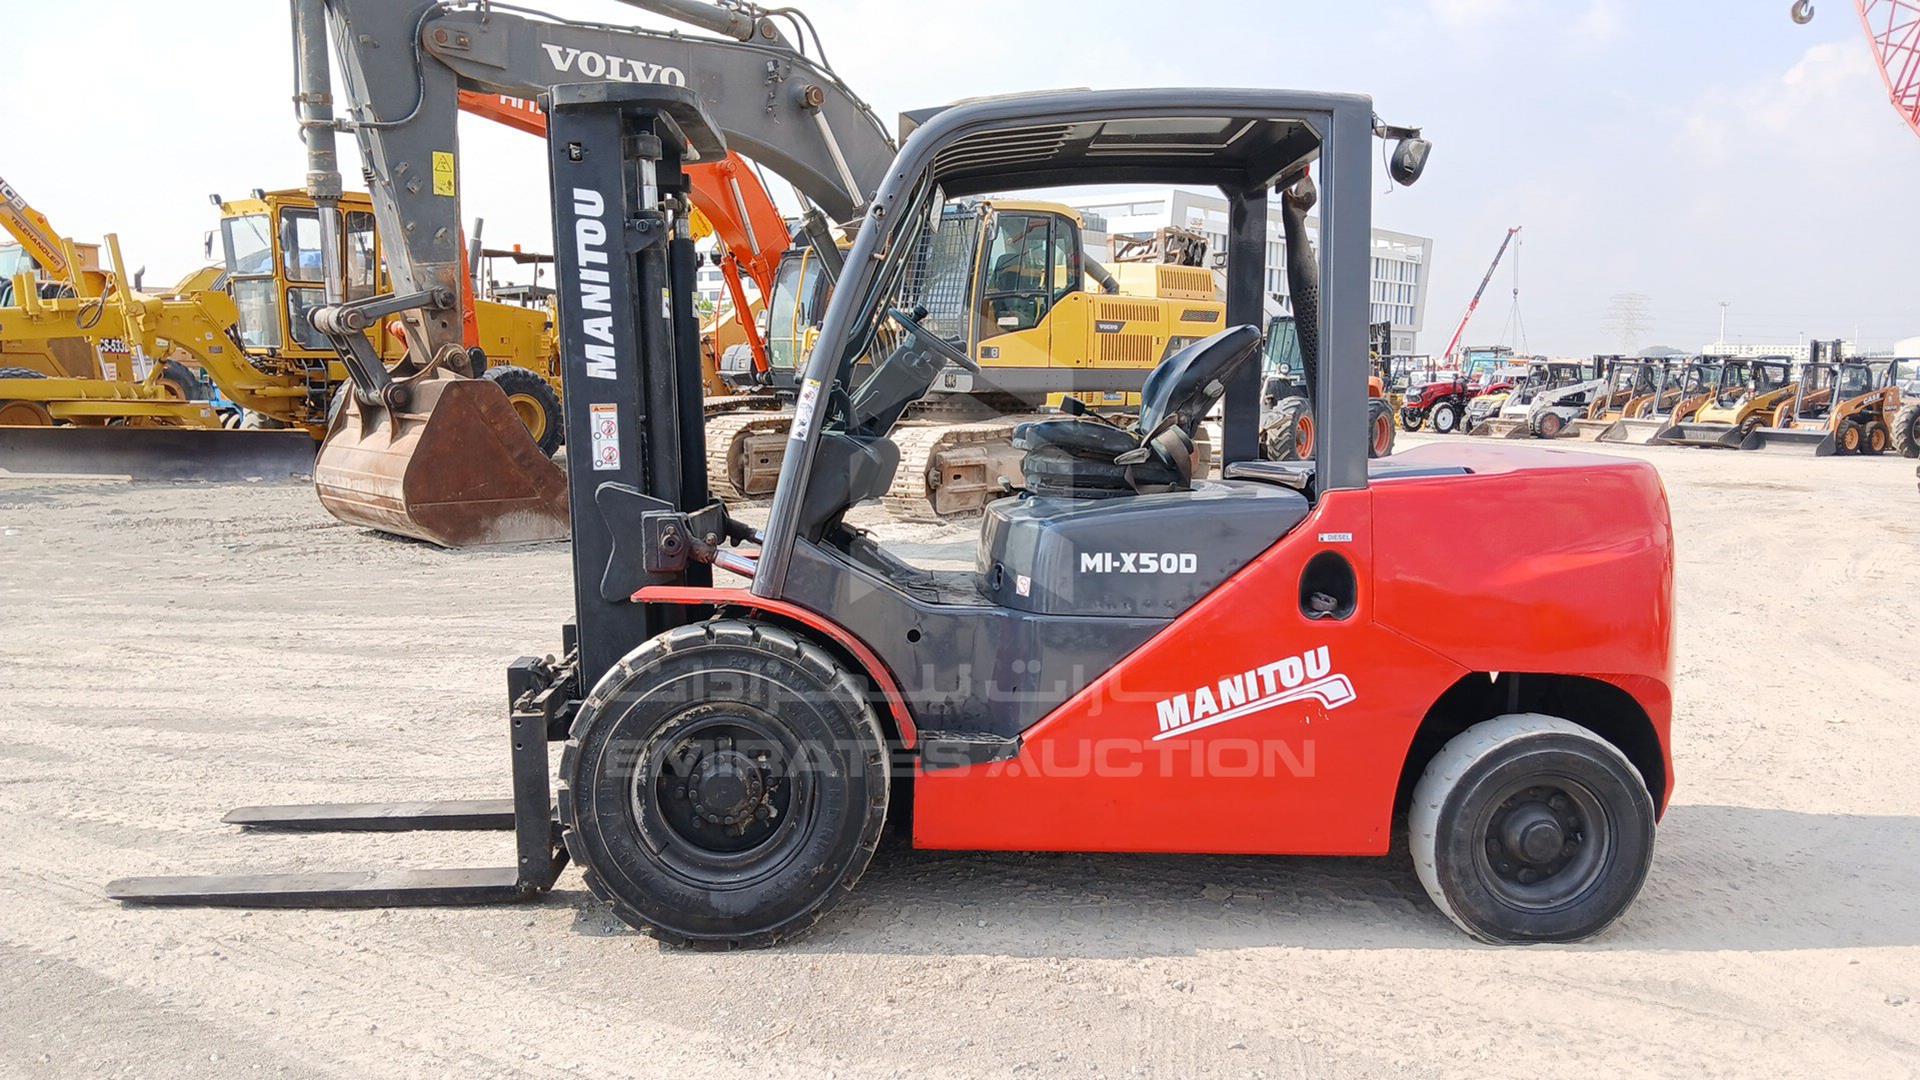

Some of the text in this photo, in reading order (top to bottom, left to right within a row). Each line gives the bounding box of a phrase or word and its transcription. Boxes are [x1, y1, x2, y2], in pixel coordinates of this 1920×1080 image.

[541, 43, 686, 88] VOLVO
[11, 215, 60, 266] TELEHANDLER
[573, 188, 617, 380] MANITOU
[1080, 552, 1197, 574] MI-X50D
[1156, 645, 1331, 732] MANITOU
